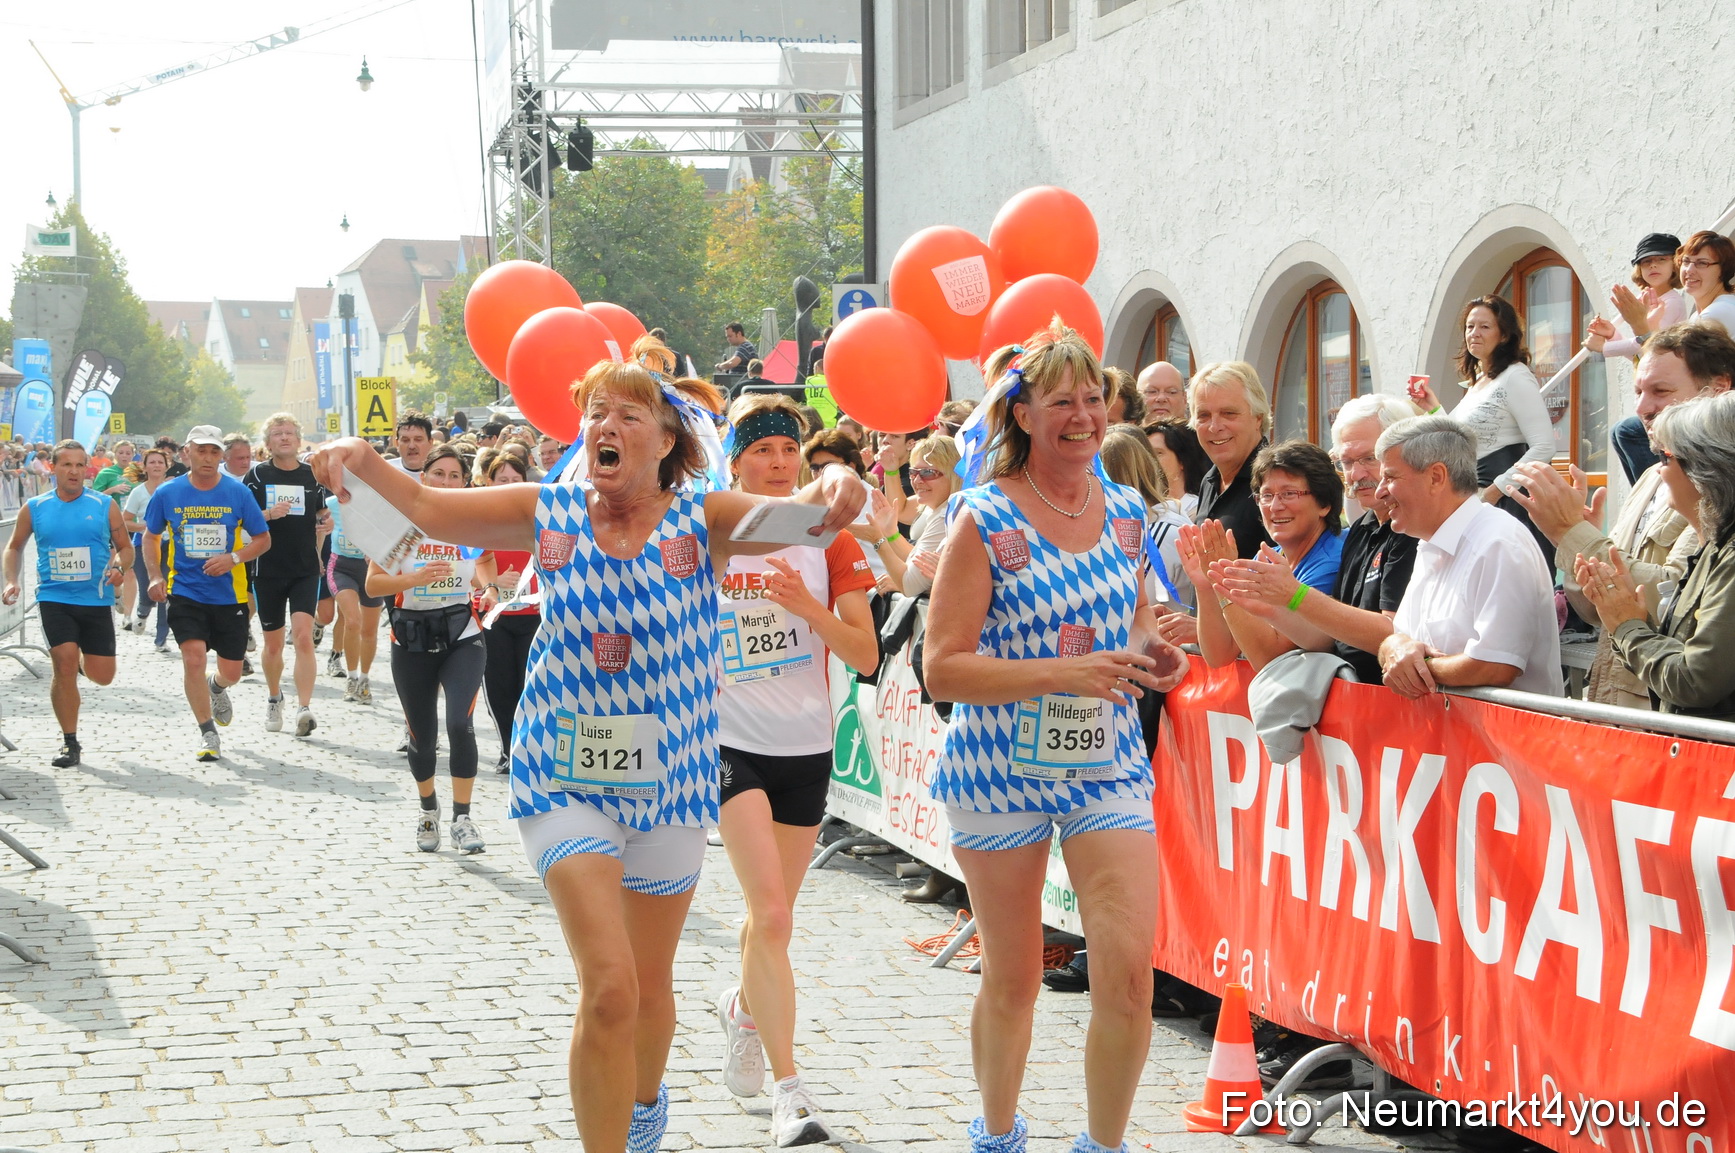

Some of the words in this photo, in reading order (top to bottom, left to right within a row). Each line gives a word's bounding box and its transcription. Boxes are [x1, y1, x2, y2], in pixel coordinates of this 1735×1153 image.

[156, 66, 184, 80] POTAIN
[944, 264, 980, 280] IMMER
[946, 272, 984, 288] WIEDER
[952, 282, 984, 301] NEU
[956, 294, 986, 310] MARKT
[360, 380, 391, 390] Block
[366, 394, 388, 422] A
[114, 420, 122, 430] B
[330, 419, 338, 429] B
[278, 496, 300, 504] 6024
[184, 506, 232, 514] NEUMARKTER
[196, 537, 222, 546] 3522
[544, 535, 570, 545] IMMER
[995, 534, 1022, 544] IMMER
[1121, 536, 1138, 546] NEU
[542, 541, 570, 552] WIEDER
[664, 540, 692, 550] IMMER
[996, 540, 1025, 550] WIEDER
[416, 550, 455, 561] Reisen
[542, 548, 567, 560] NEU
[664, 546, 694, 556] WIEDER
[1000, 546, 1026, 560] NEU
[60, 560, 86, 570] 3410
[542, 558, 564, 566] MARKT
[668, 554, 693, 566] NEU
[1003, 556, 1028, 567] MARKT
[670, 564, 694, 572] MARKT
[430, 577, 462, 588] 2882
[502, 589, 527, 600] 354
[742, 612, 776, 628] Margit
[1064, 630, 1090, 638] IMMER
[726, 638, 732, 648] A
[746, 628, 798, 656] 2821
[1063, 636, 1090, 646] WIEDER
[597, 644, 626, 652] WIEDER
[1062, 644, 1088, 656] NEU
[598, 651, 624, 661] NEU
[780, 660, 813, 672] PFLEIDERER
[1048, 700, 1102, 722] Hildegard
[580, 721, 612, 740] Luise
[1023, 722, 1030, 734] D
[1046, 727, 1105, 751] 3599
[560, 740, 566, 752] D
[580, 747, 642, 770] 3121
[1078, 766, 1112, 775] PFLEIDERER
[615, 787, 657, 795] PFLEIDERER
